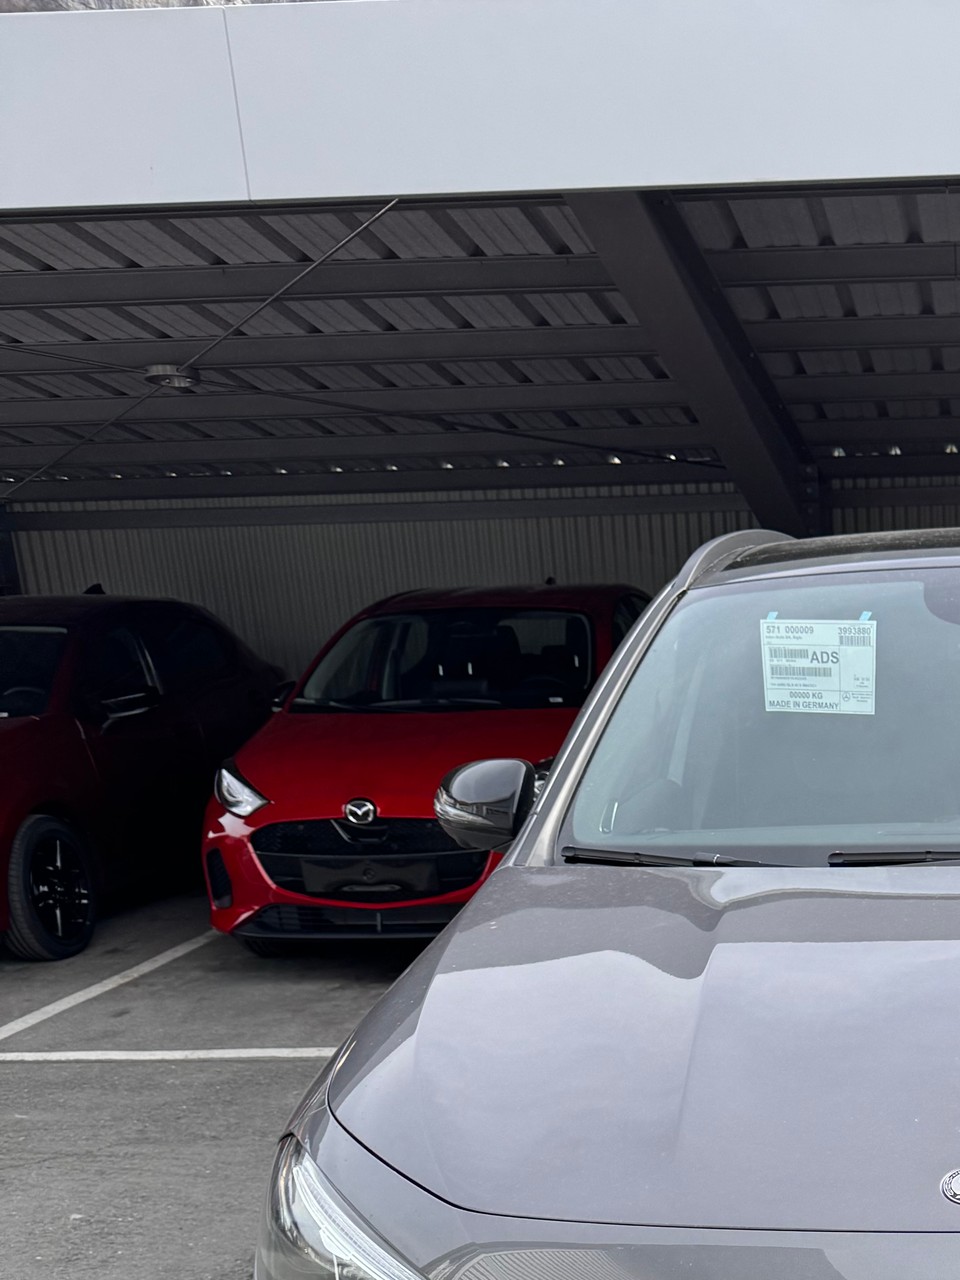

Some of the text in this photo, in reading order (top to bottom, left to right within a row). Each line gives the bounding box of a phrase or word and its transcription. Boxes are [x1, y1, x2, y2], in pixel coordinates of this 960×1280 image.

[810, 651, 840, 664] ADS
[811, 692, 823, 700] KG
[769, 700, 791, 708] MADE
[802, 701, 839, 710] GERMANY
